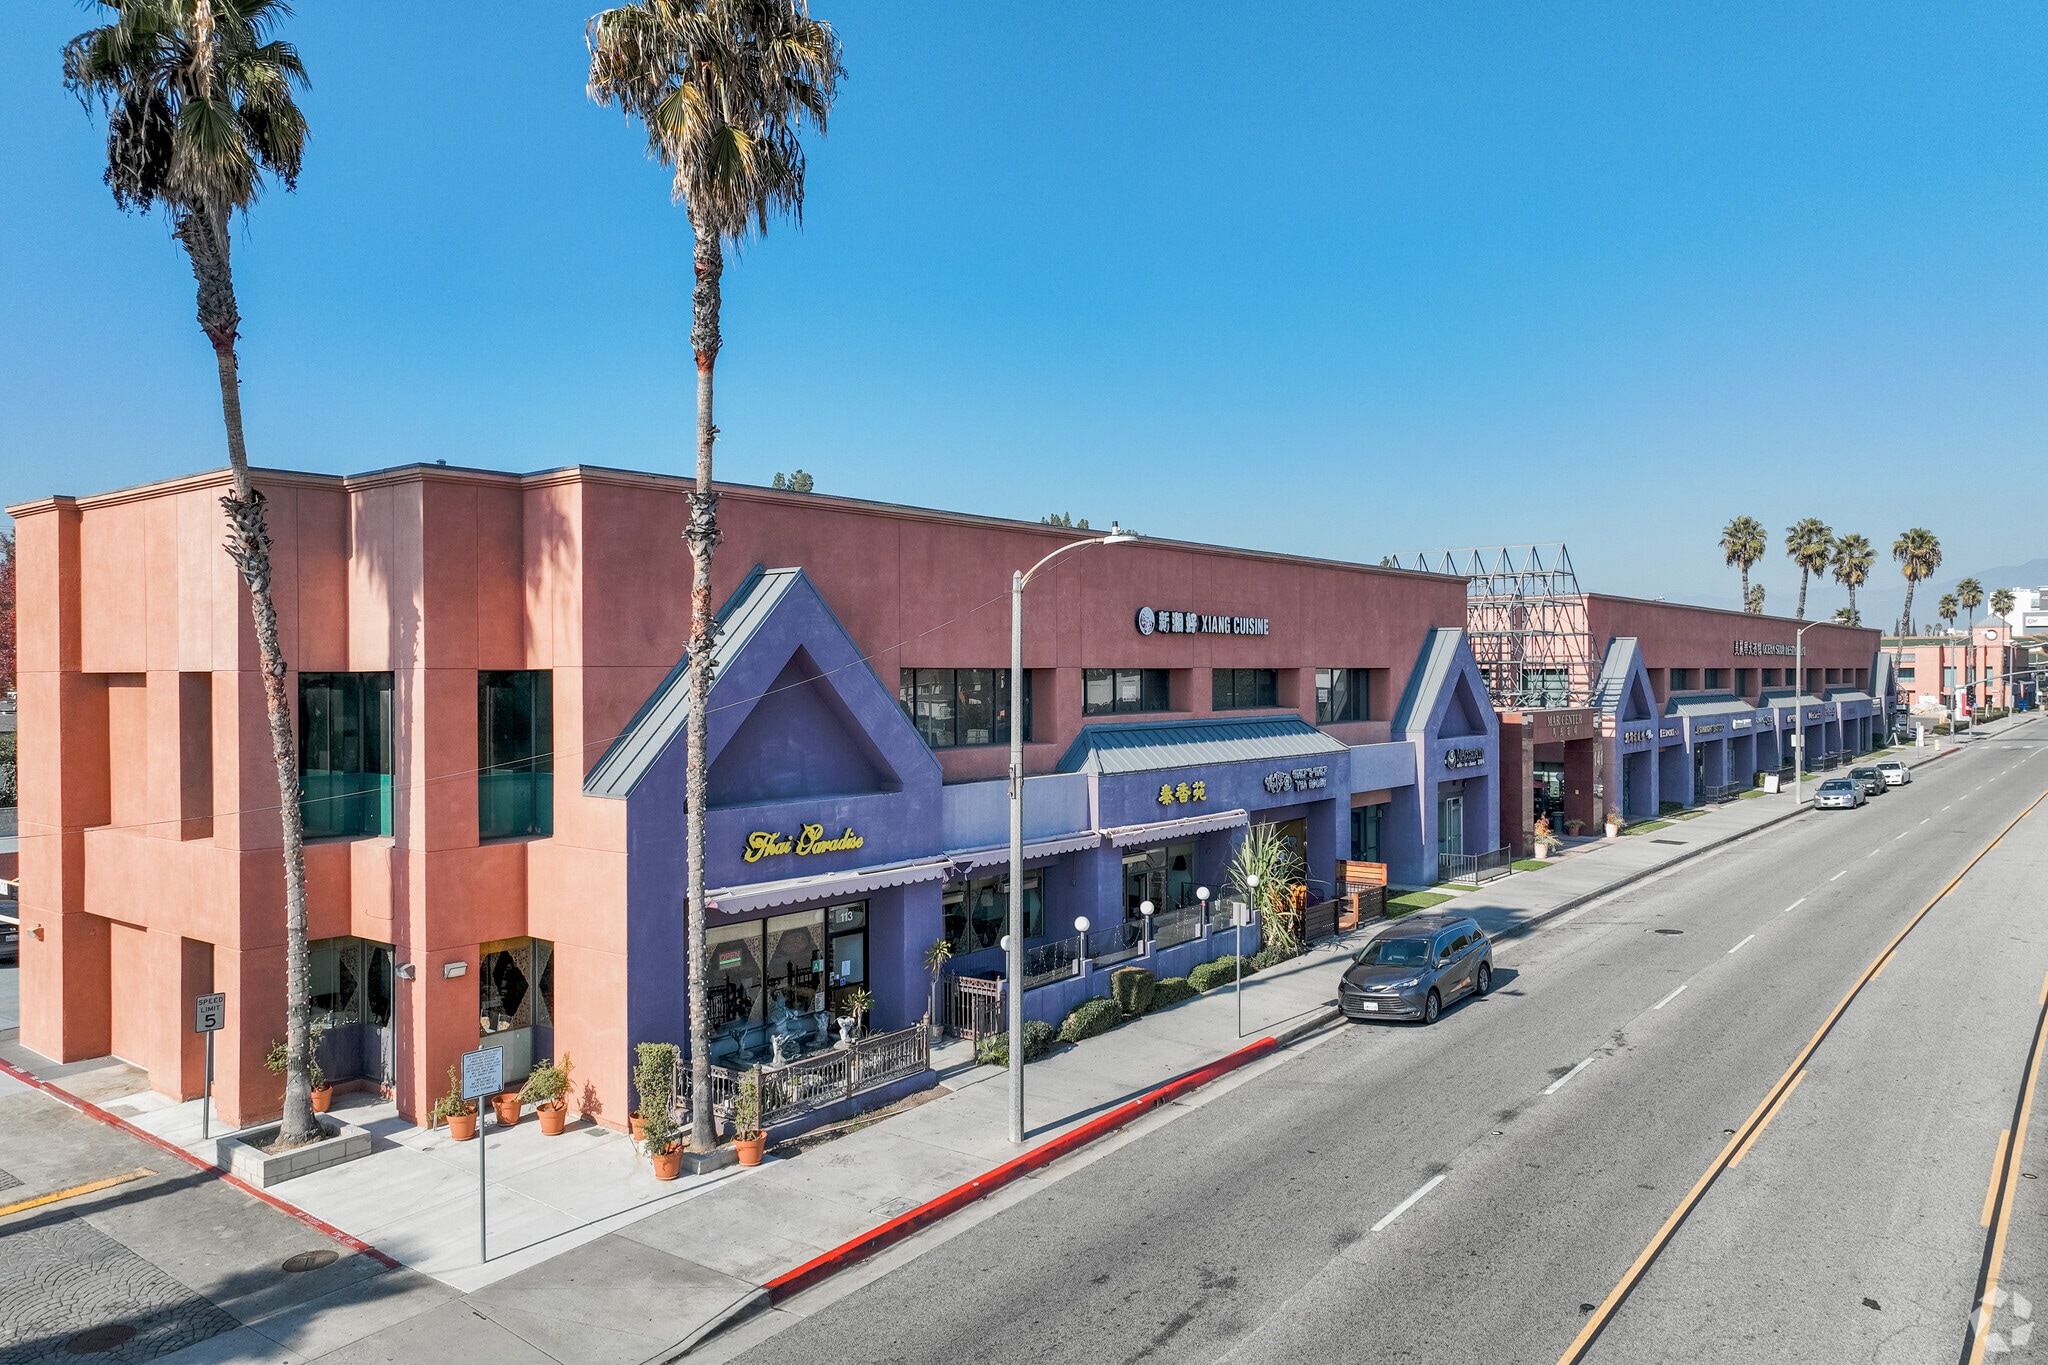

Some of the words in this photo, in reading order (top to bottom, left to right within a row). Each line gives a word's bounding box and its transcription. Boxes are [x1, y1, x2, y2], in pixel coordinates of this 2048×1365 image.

[1201, 615, 1231, 633] XIANG
[1233, 617, 1269, 635] CUISINE
[1561, 714, 1582, 726] CENTER
[742, 831, 793, 863] Thai
[795, 823, 864, 856] Paradise
[840, 911, 853, 923] 113
[719, 950, 742, 962] OPEN
[198, 996, 224, 1006] SPEED
[200, 1004, 221, 1013] LIMIT
[204, 1013, 216, 1028] 5
